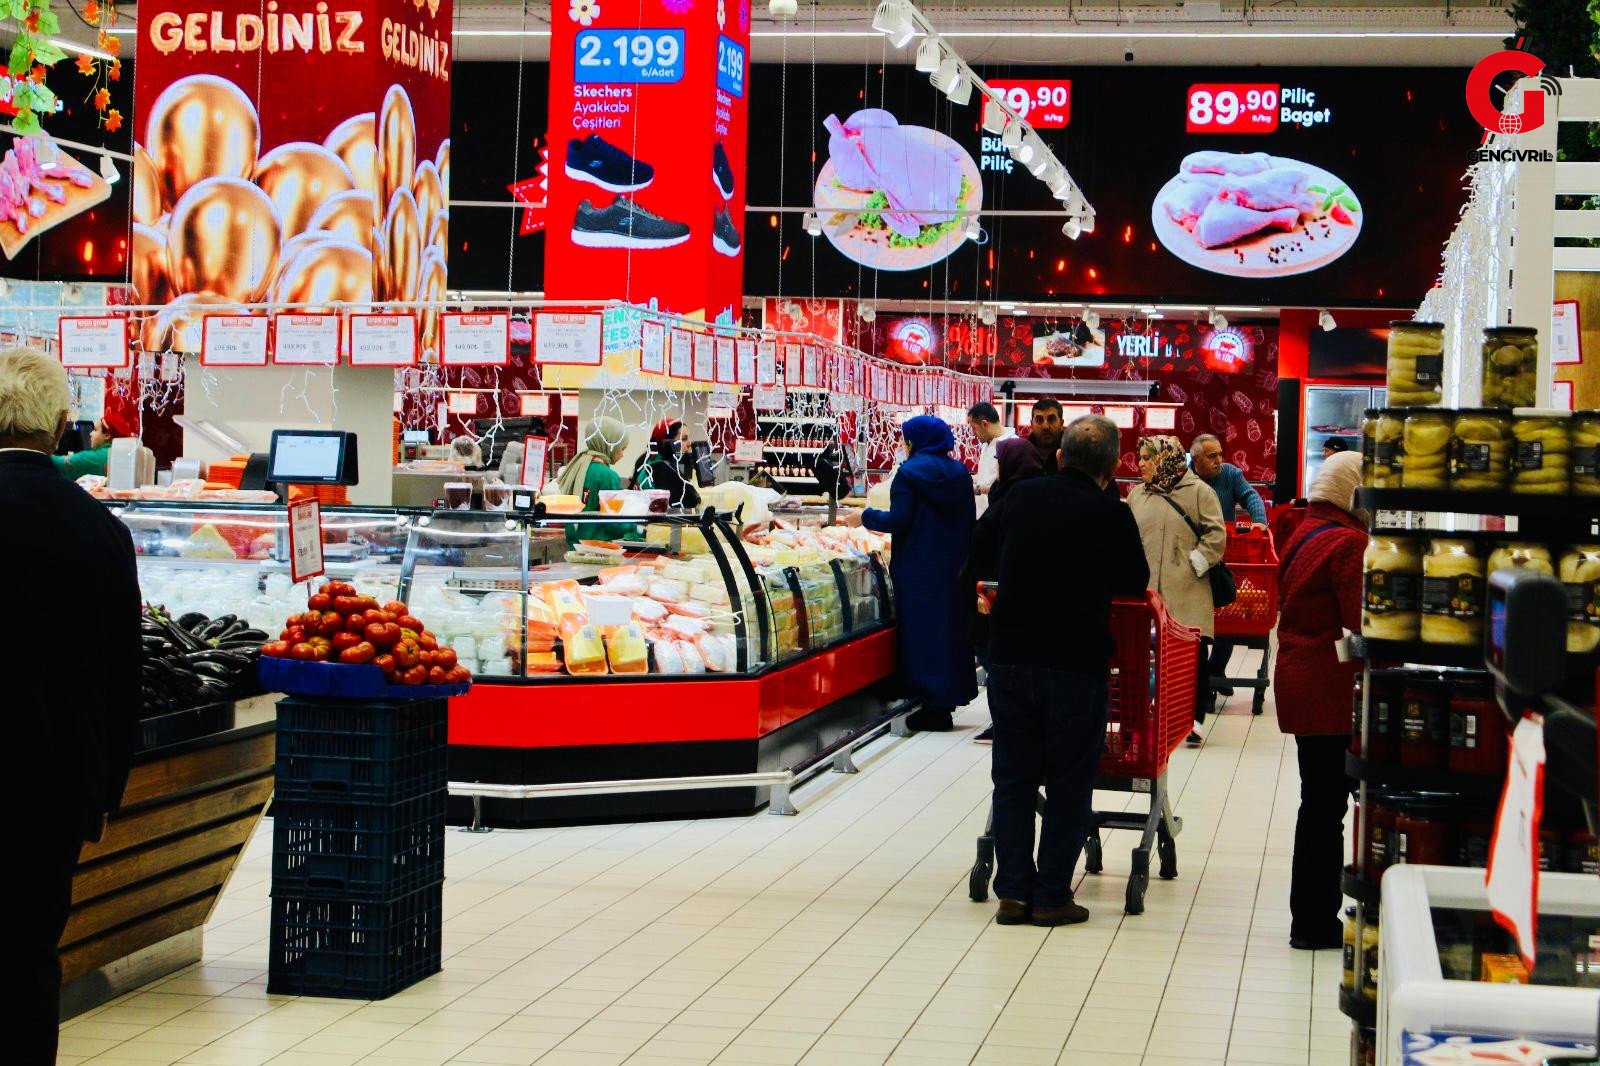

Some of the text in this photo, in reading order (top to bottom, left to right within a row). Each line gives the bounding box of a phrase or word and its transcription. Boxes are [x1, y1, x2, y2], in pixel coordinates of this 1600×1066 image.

[150, 1, 365, 55] GELDİNİZ
[381, 17, 448, 81] GELDİNİZ
[579, 35, 679, 67] 2.199
[718, 41, 743, 81] 2.199
[573, 85, 633, 98] Skechers
[1281, 87, 1316, 107] Piliç
[573, 101, 630, 116] Ayakkabı
[1189, 90, 1277, 125] 89,90
[1280, 107, 1331, 127] Baget
[572, 116, 621, 130] Çeşitleri
[980, 154, 1014, 174] Piliç
[1116, 331, 1160, 357] YERLİ
